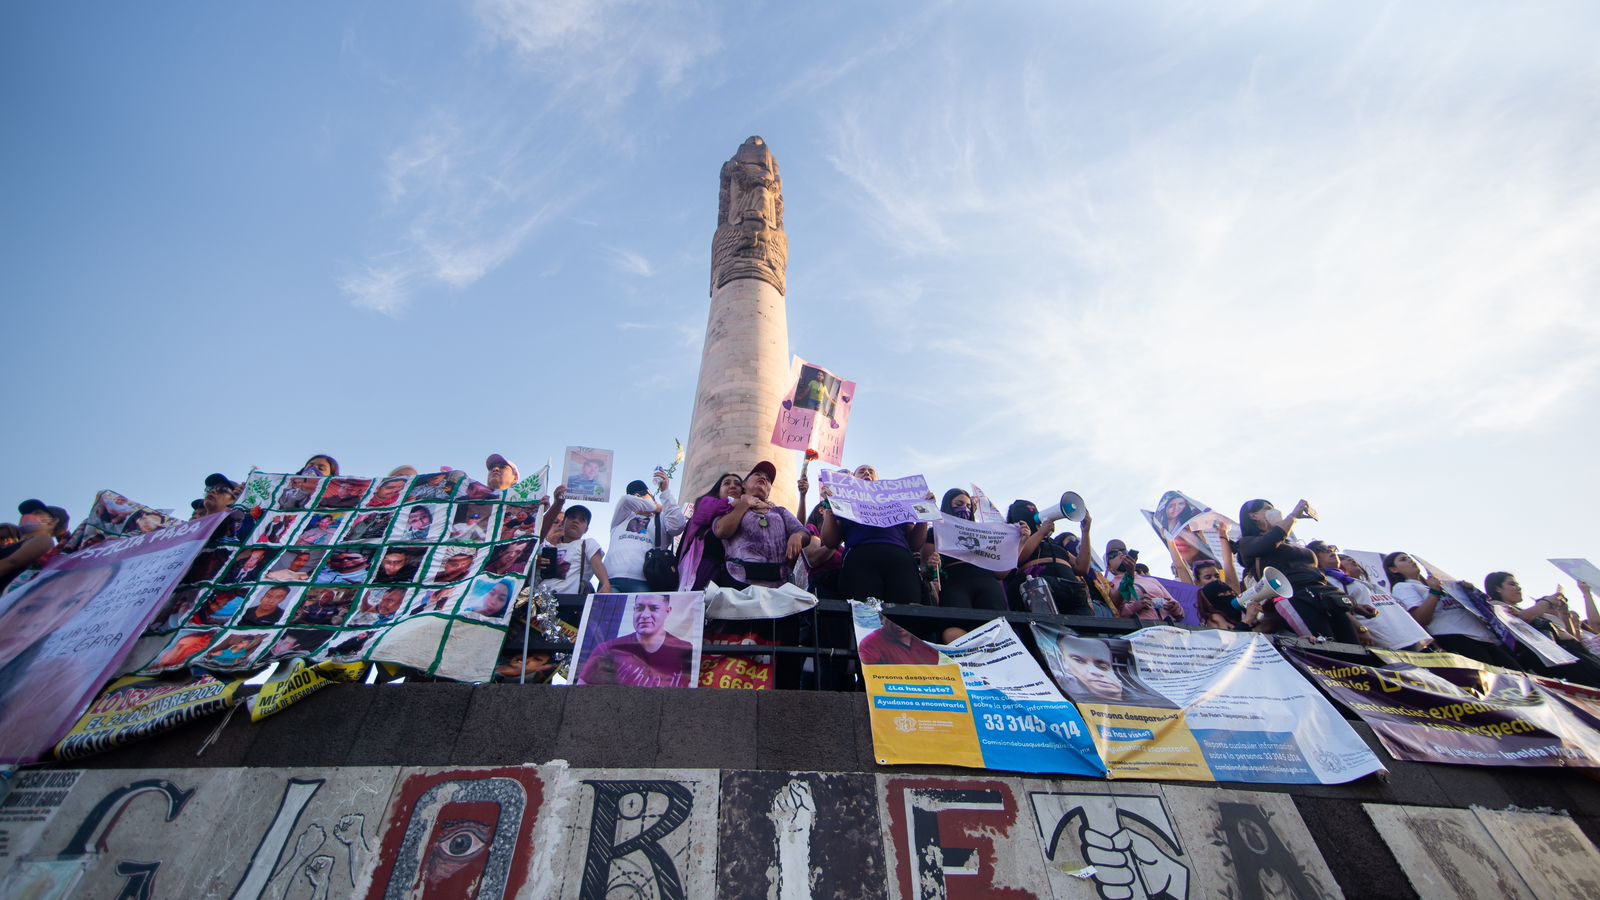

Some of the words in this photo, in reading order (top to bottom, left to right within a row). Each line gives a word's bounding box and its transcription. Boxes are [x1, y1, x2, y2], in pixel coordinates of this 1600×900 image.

[783, 411, 800, 425] Por
[863, 477, 926, 492] KRISTINA
[829, 487, 876, 503] UNGUIA
[864, 512, 917, 526] JUSTICIA
[149, 521, 201, 543] PARA
[725, 657, 769, 682] 7544
[1307, 665, 1368, 679] Exigimos
[905, 674, 956, 682] desaparecida
[1322, 678, 1350, 689] para
[1349, 680, 1371, 691] los
[86, 716, 105, 730] EL
[128, 693, 187, 722] OCTUBRE
[188, 684, 225, 703] 2020
[281, 698, 289, 708] DE
[922, 701, 965, 709] encontrarla
[1090, 709, 1123, 719] Persona
[983, 714, 1005, 731] 33
[1006, 715, 1046, 733] 3145
[1459, 717, 1538, 739] perspecti
[1114, 730, 1127, 738] has
[1499, 747, 1546, 760] Imelda
